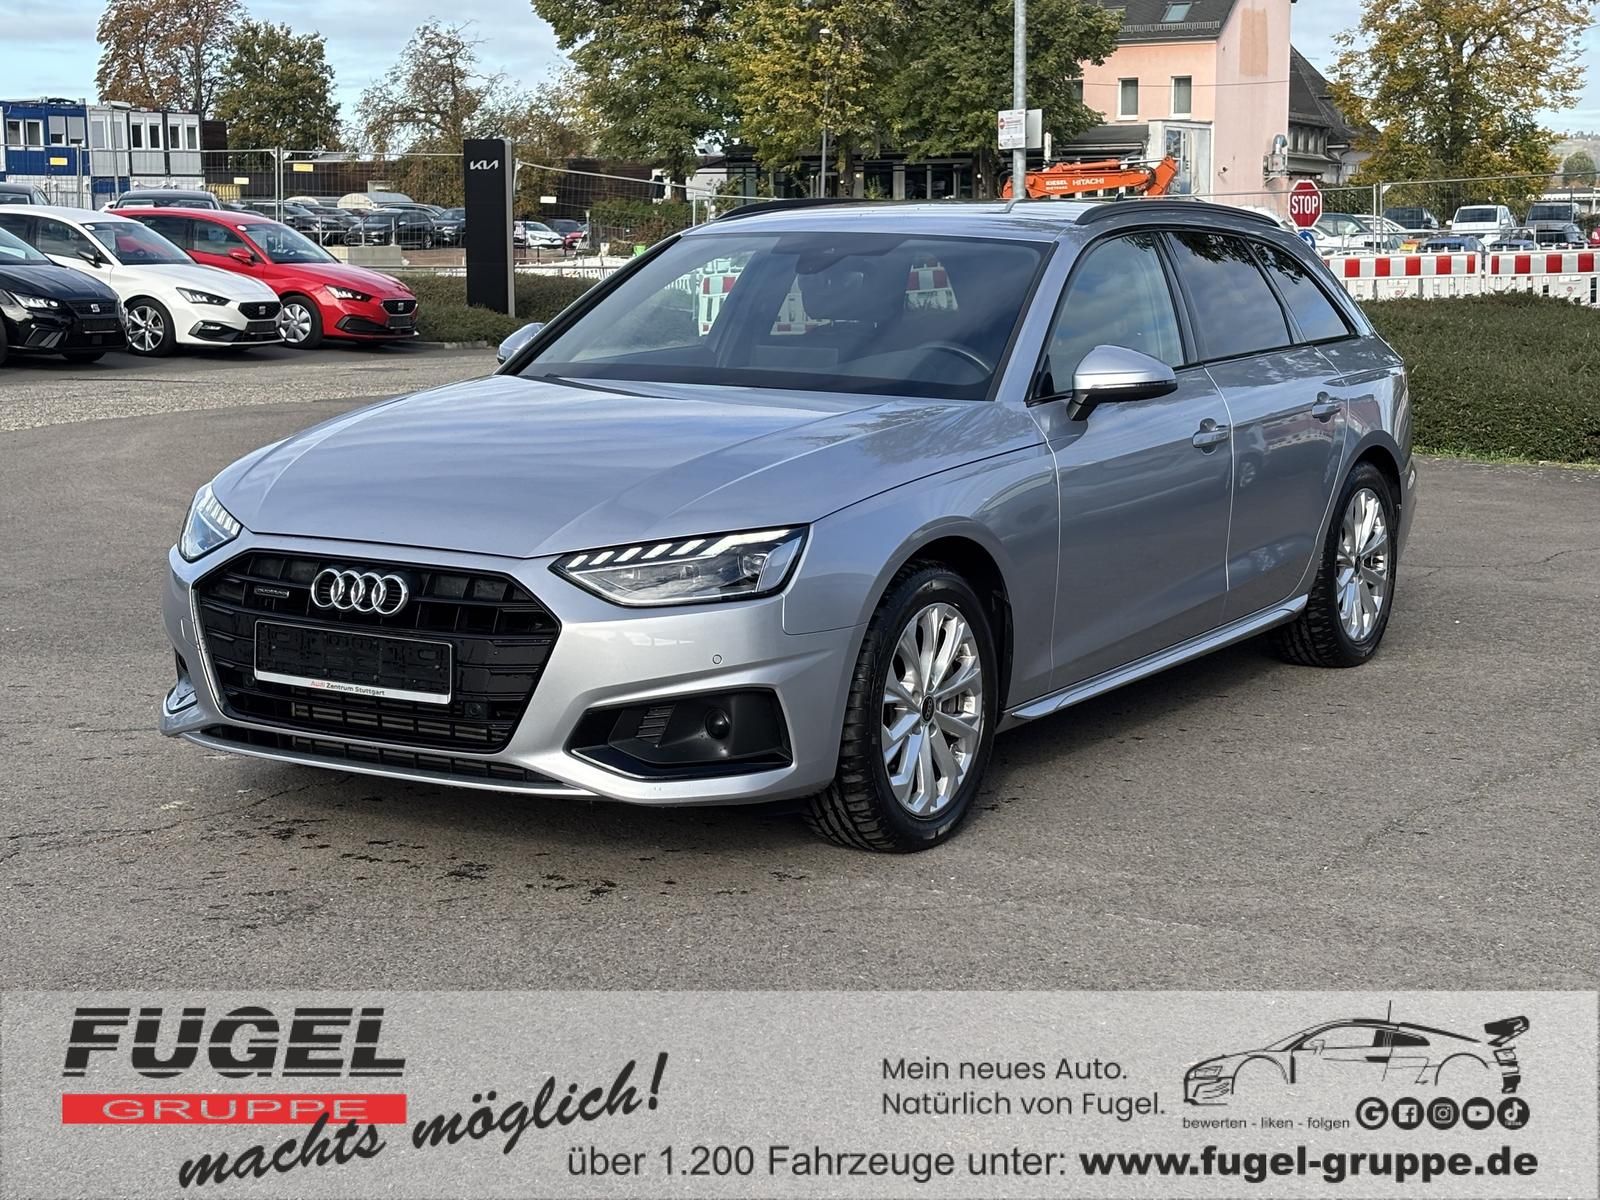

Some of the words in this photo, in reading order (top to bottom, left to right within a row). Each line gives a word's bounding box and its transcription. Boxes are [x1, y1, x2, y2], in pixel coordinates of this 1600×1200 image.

[469, 159, 499, 170] KIA
[1072, 178, 1104, 186] HITACHI
[1291, 195, 1319, 215] STOP
[310, 680, 325, 688] Audi
[326, 682, 354, 692] Zentrum
[354, 686, 385, 696] Stuttgart
